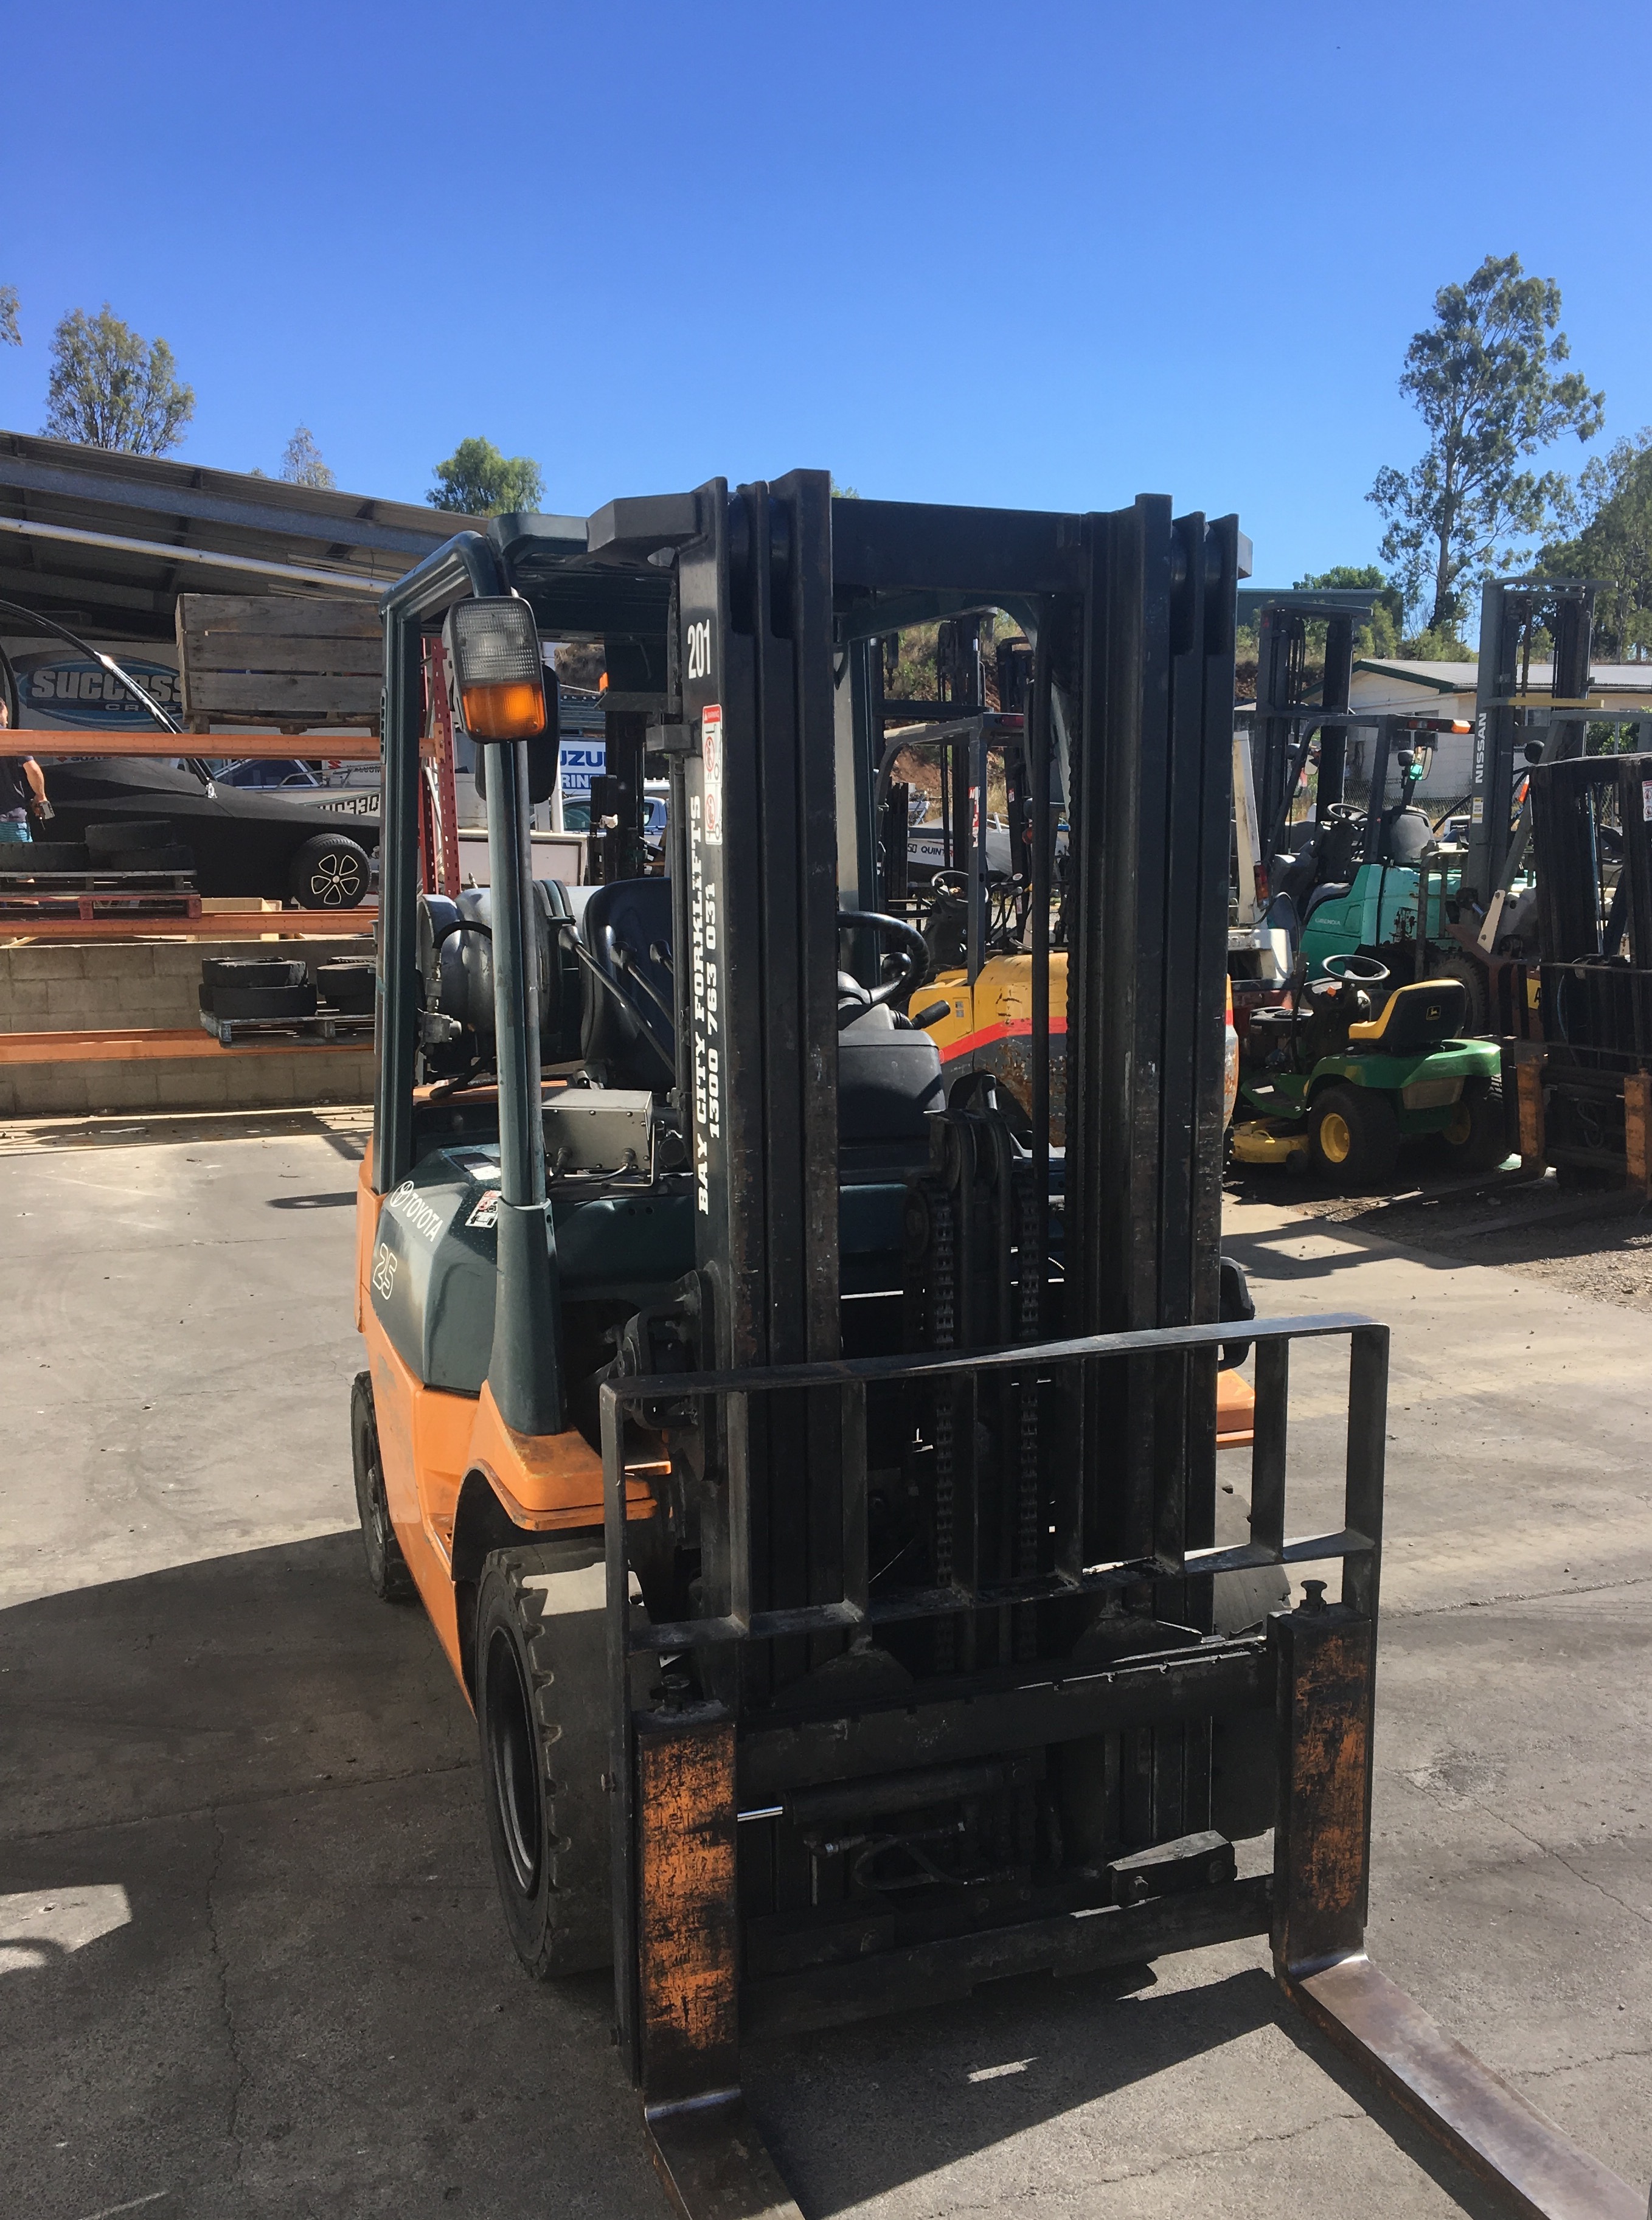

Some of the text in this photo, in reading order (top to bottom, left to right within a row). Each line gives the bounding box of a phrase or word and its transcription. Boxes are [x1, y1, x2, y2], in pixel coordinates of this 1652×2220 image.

[687, 619, 711, 679] 201
[1475, 712, 1487, 783] NISSAN
[561, 774, 600, 788] RIN
[690, 795, 709, 1215] BAY CITY FORKLIFTS
[705, 883, 720, 1139] 1300 763 031
[402, 1192, 443, 1242] TOYOTA
[372, 1243, 398, 1300] 25
